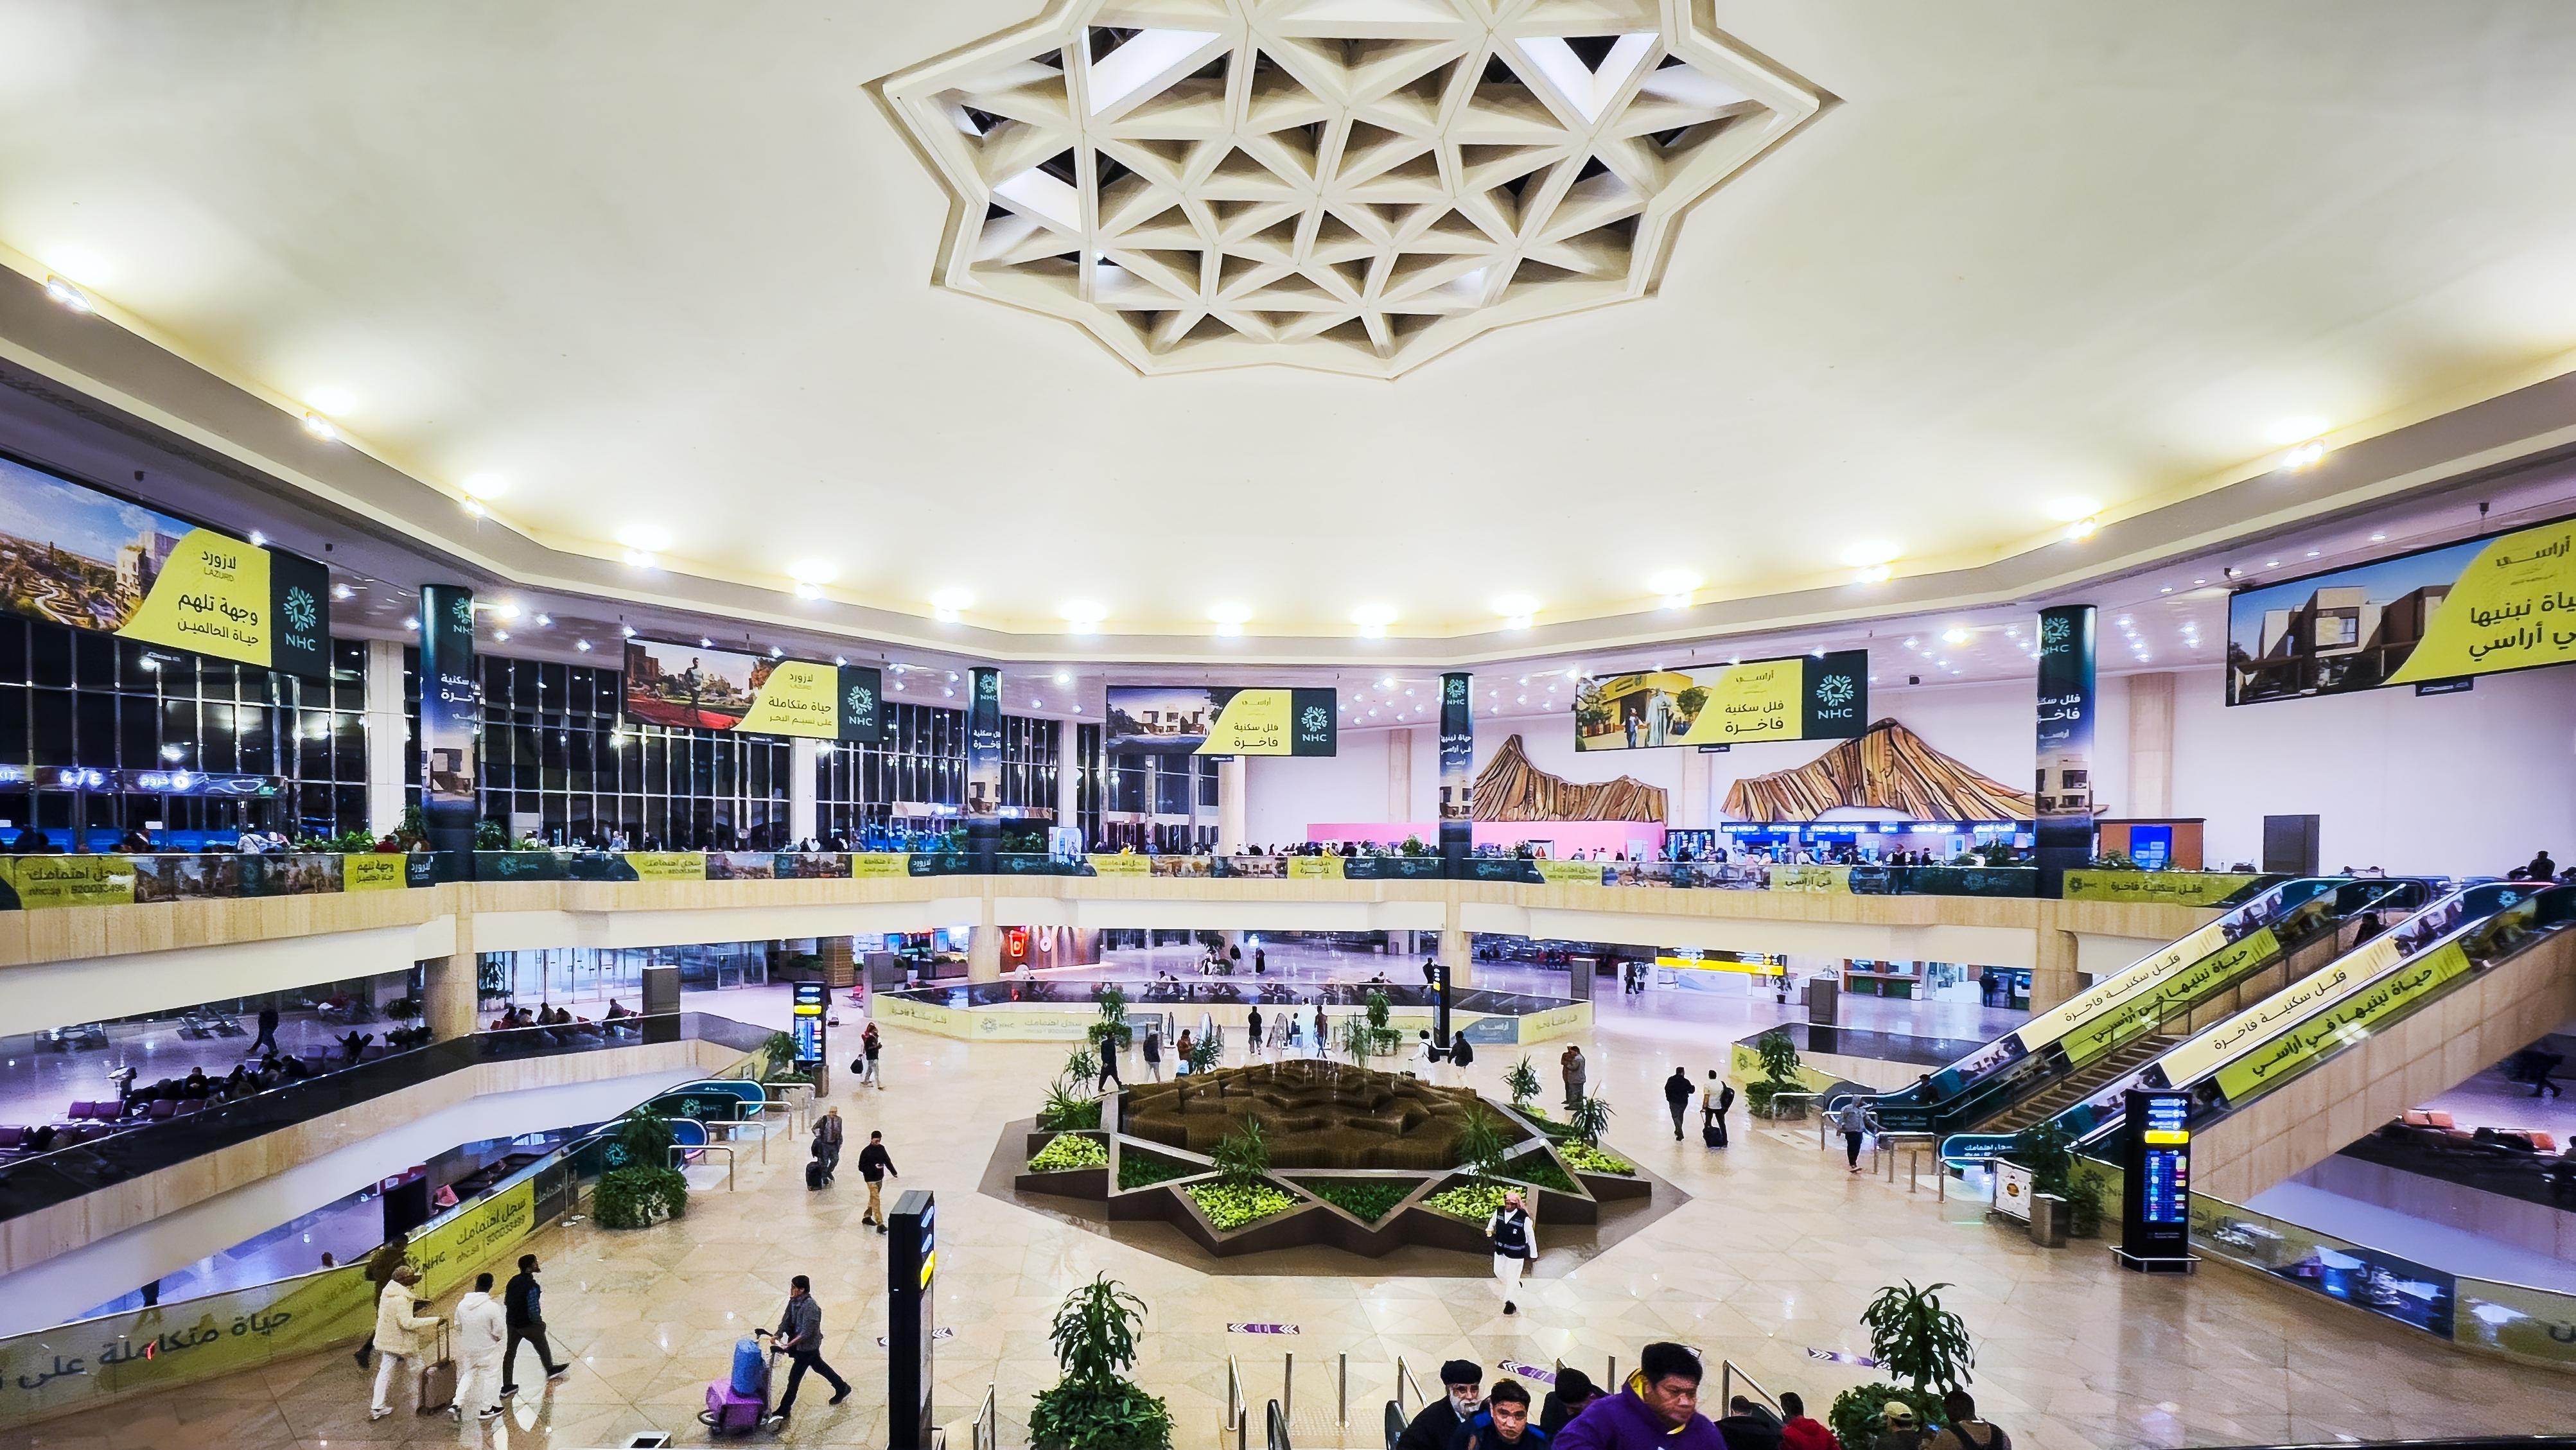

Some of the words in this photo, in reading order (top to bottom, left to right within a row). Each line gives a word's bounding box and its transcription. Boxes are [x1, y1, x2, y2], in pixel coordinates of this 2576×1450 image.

[202, 551, 236, 570] لازورد
[204, 567, 234, 582] LAZURD
[178, 594, 215, 612] تلهم
[220, 597, 258, 626] وجهة
[2470, 598, 2532, 627] نبنيها
[177, 618, 229, 638] الحالمين
[232, 629, 259, 647] حياة
[285, 633, 316, 651] NHC
[2468, 621, 2543, 662] أراسي
[2553, 632, 2576, 650] ي
[789, 674, 813, 683] لازورد
[769, 696, 807, 710] متكاملة
[811, 701, 831, 714] حياة
[1763, 700, 1783, 713] فلل
[2060, 693, 2081, 705] فلل
[1725, 704, 1759, 716] سكنية
[1818, 708, 1853, 720] NHC
[848, 715, 873, 726] NHC
[1234, 722, 1259, 732] سكنية
[1263, 723, 1279, 732] فلل
[1725, 717, 1783, 735] فاخرة
[1234, 737, 1278, 749] فاخرة
[139, 776, 170, 787] خروج
[2212, 950, 2247, 974] حياة
[2105, 972, 2150, 999] سكنية
[2165, 968, 2211, 998] نبنيها
[2392, 968, 2433, 996] حياة
[2065, 995, 2104, 1022] فاخرة
[2261, 992, 2312, 1024] سكنية
[2336, 989, 2390, 1024] نبنيها
[2214, 1018, 2258, 1051] فاخرة
[2305, 1018, 2337, 1048] في
[2252, 1035, 2304, 1078] أراسي
[502, 1198, 527, 1223] سجل
[457, 1209, 500, 1245] اهتمامك
[421, 1251, 446, 1273] NHC
[231, 1311, 293, 1336] حياة
[98, 1328, 220, 1365] متكاملة
[18, 1355, 87, 1390] على
